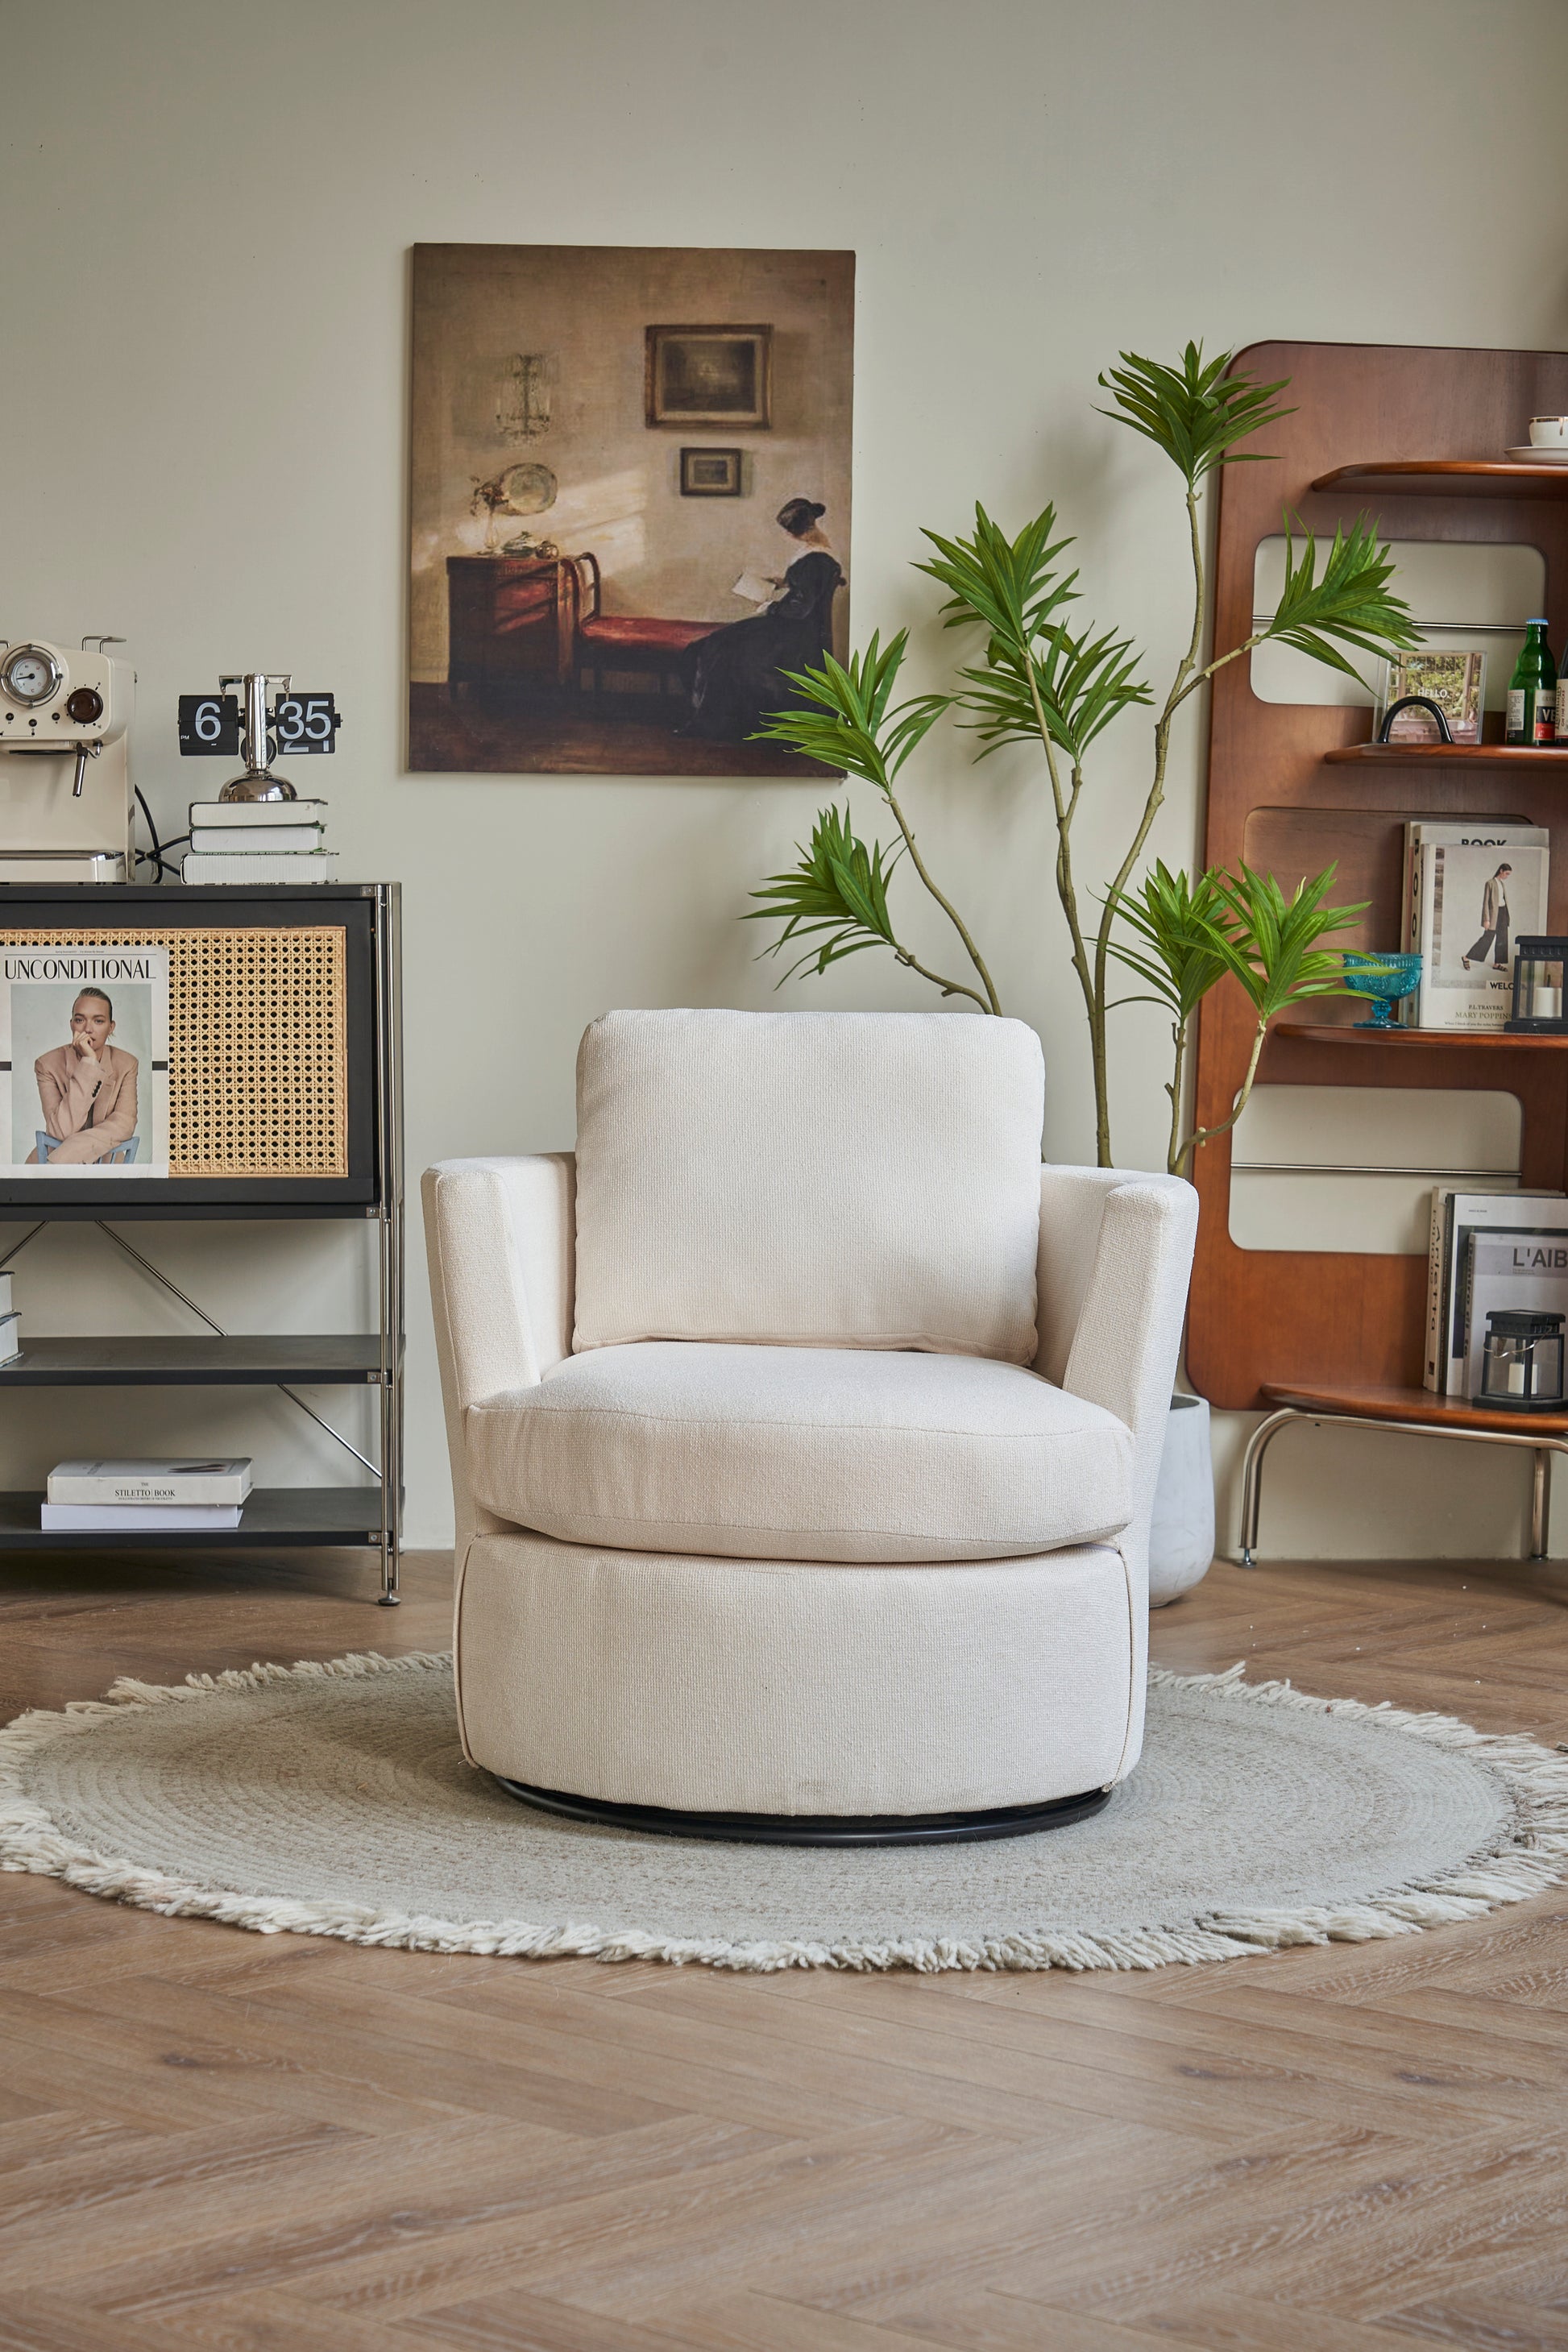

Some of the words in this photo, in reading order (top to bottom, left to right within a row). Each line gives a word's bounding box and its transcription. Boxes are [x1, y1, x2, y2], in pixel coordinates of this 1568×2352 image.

[195, 701, 222, 740] 6
[279, 700, 332, 740] 35
[5, 959, 157, 980] UNCONDITIONAL
[1490, 981, 1514, 990] WELC
[1455, 1011, 1479, 1019] MARY
